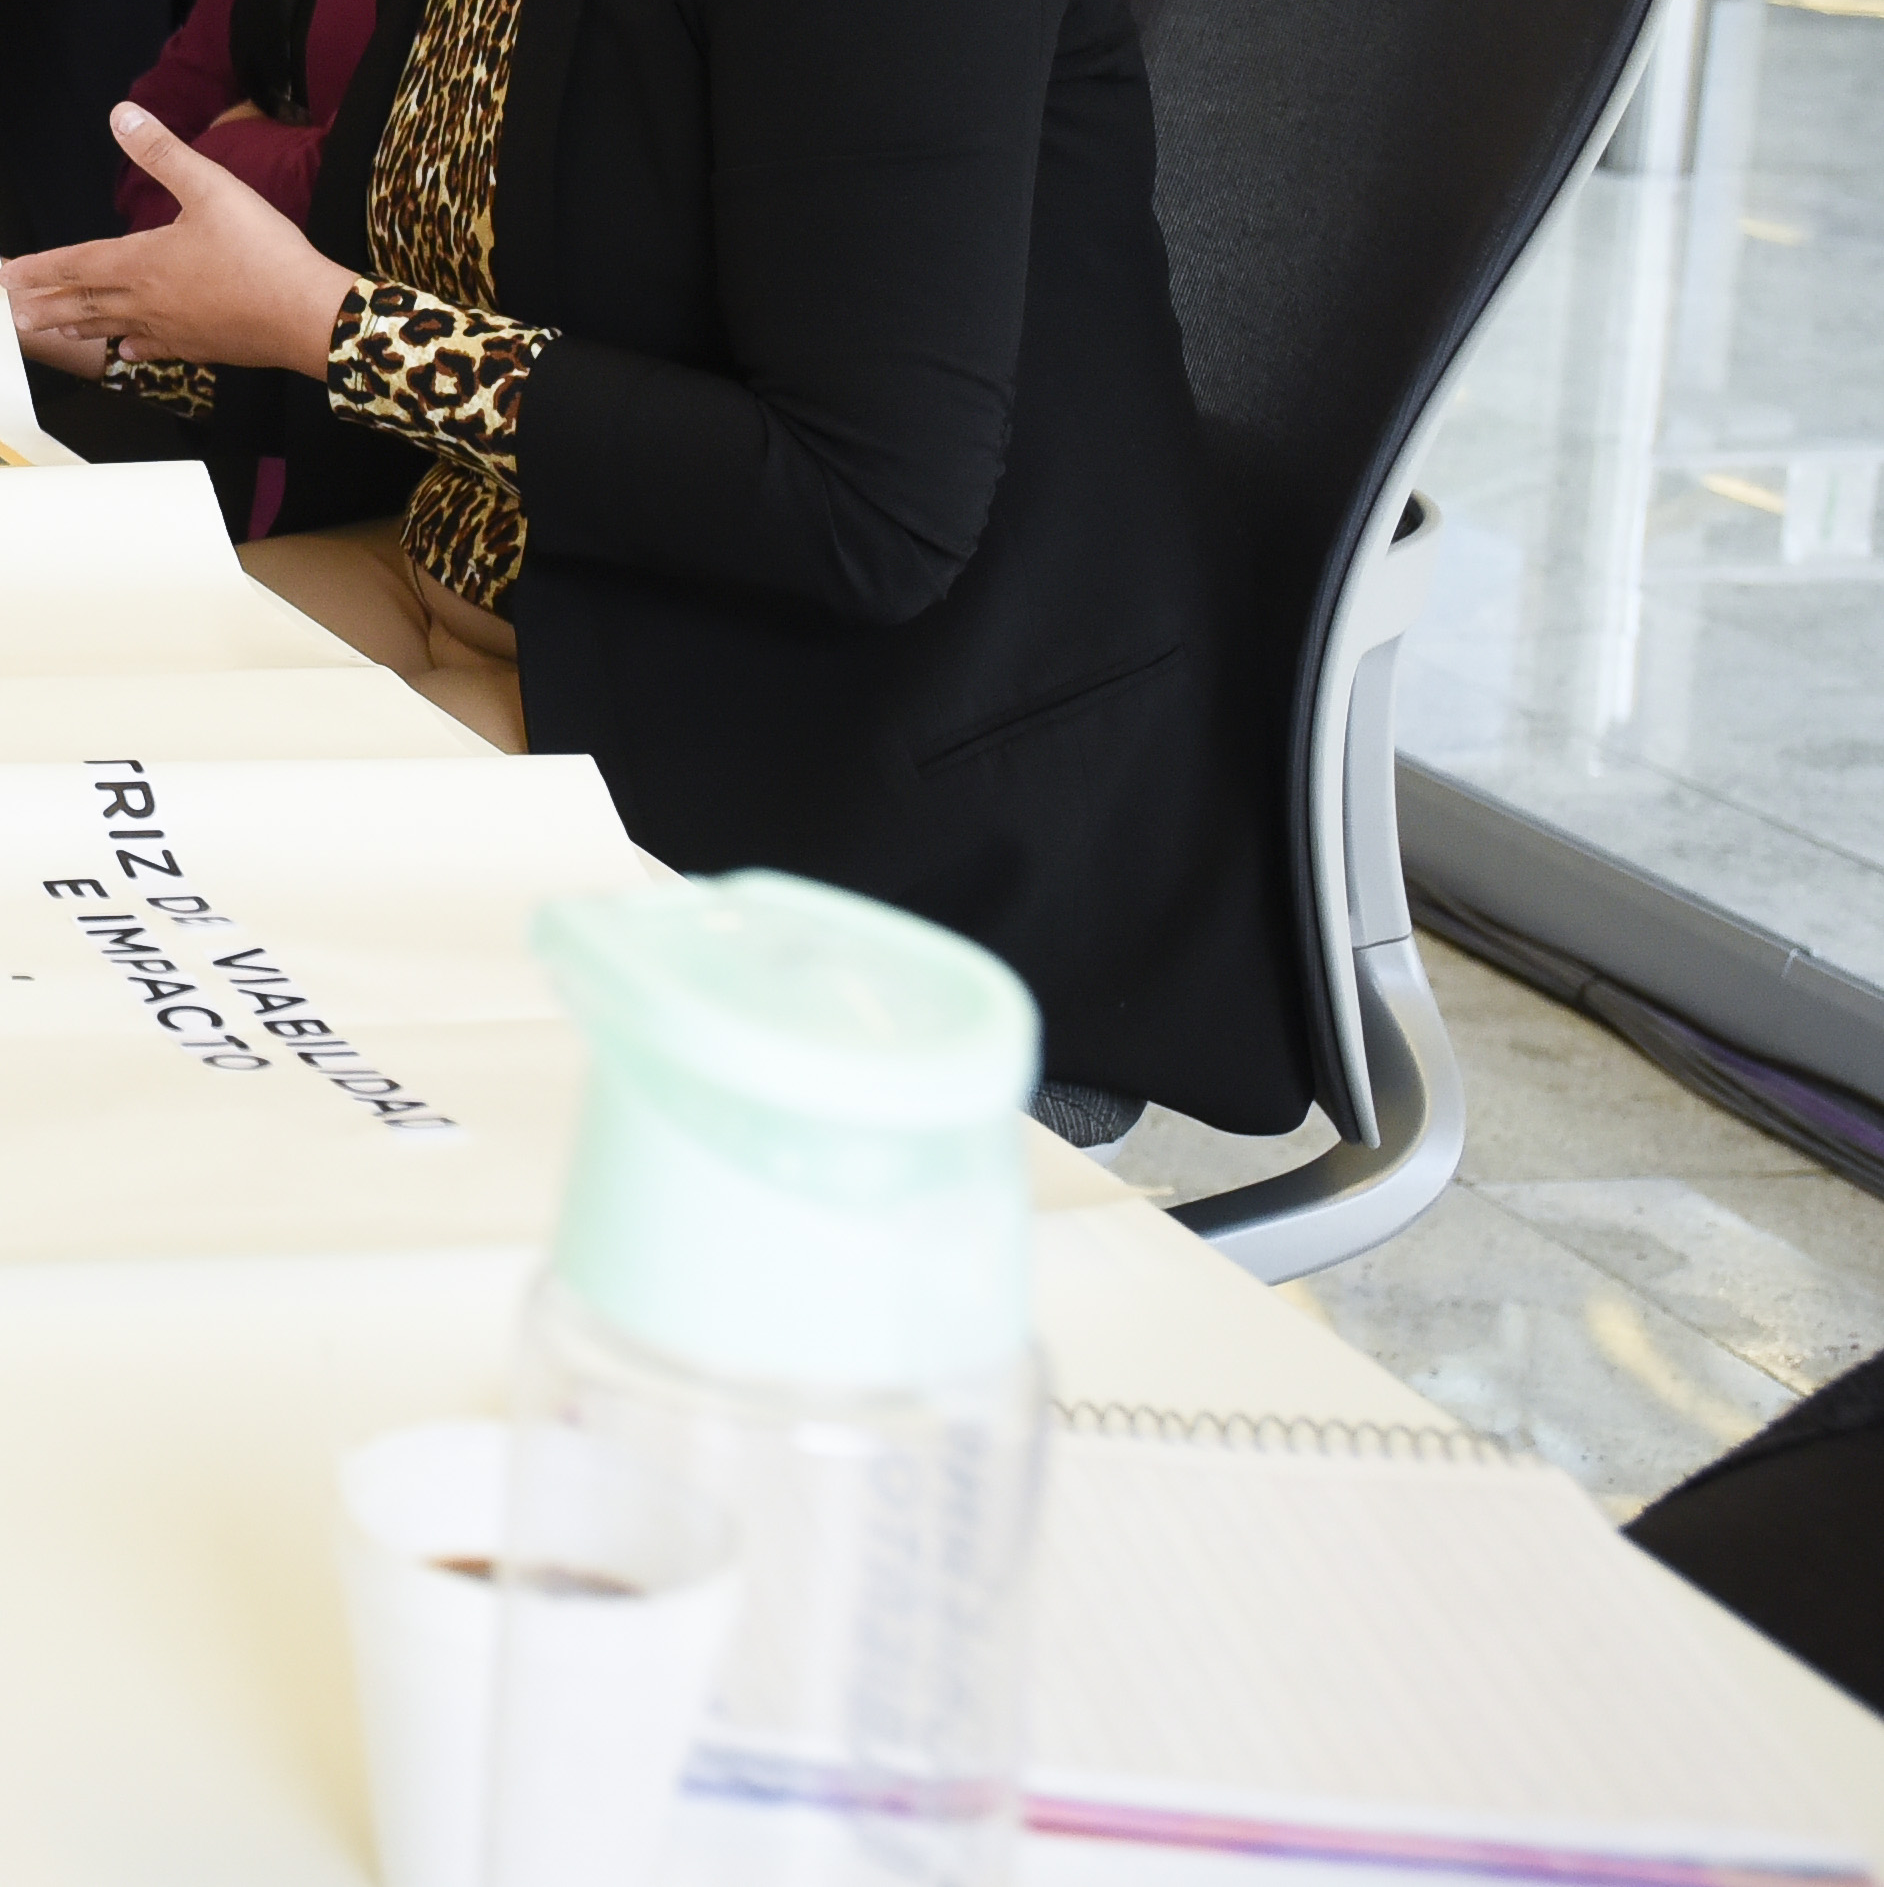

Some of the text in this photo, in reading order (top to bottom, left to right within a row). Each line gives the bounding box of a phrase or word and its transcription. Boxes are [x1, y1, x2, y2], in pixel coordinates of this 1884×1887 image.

[42, 878, 273, 1071] E IMPACTO
[212, 947, 460, 1130] VIABILIDAD
